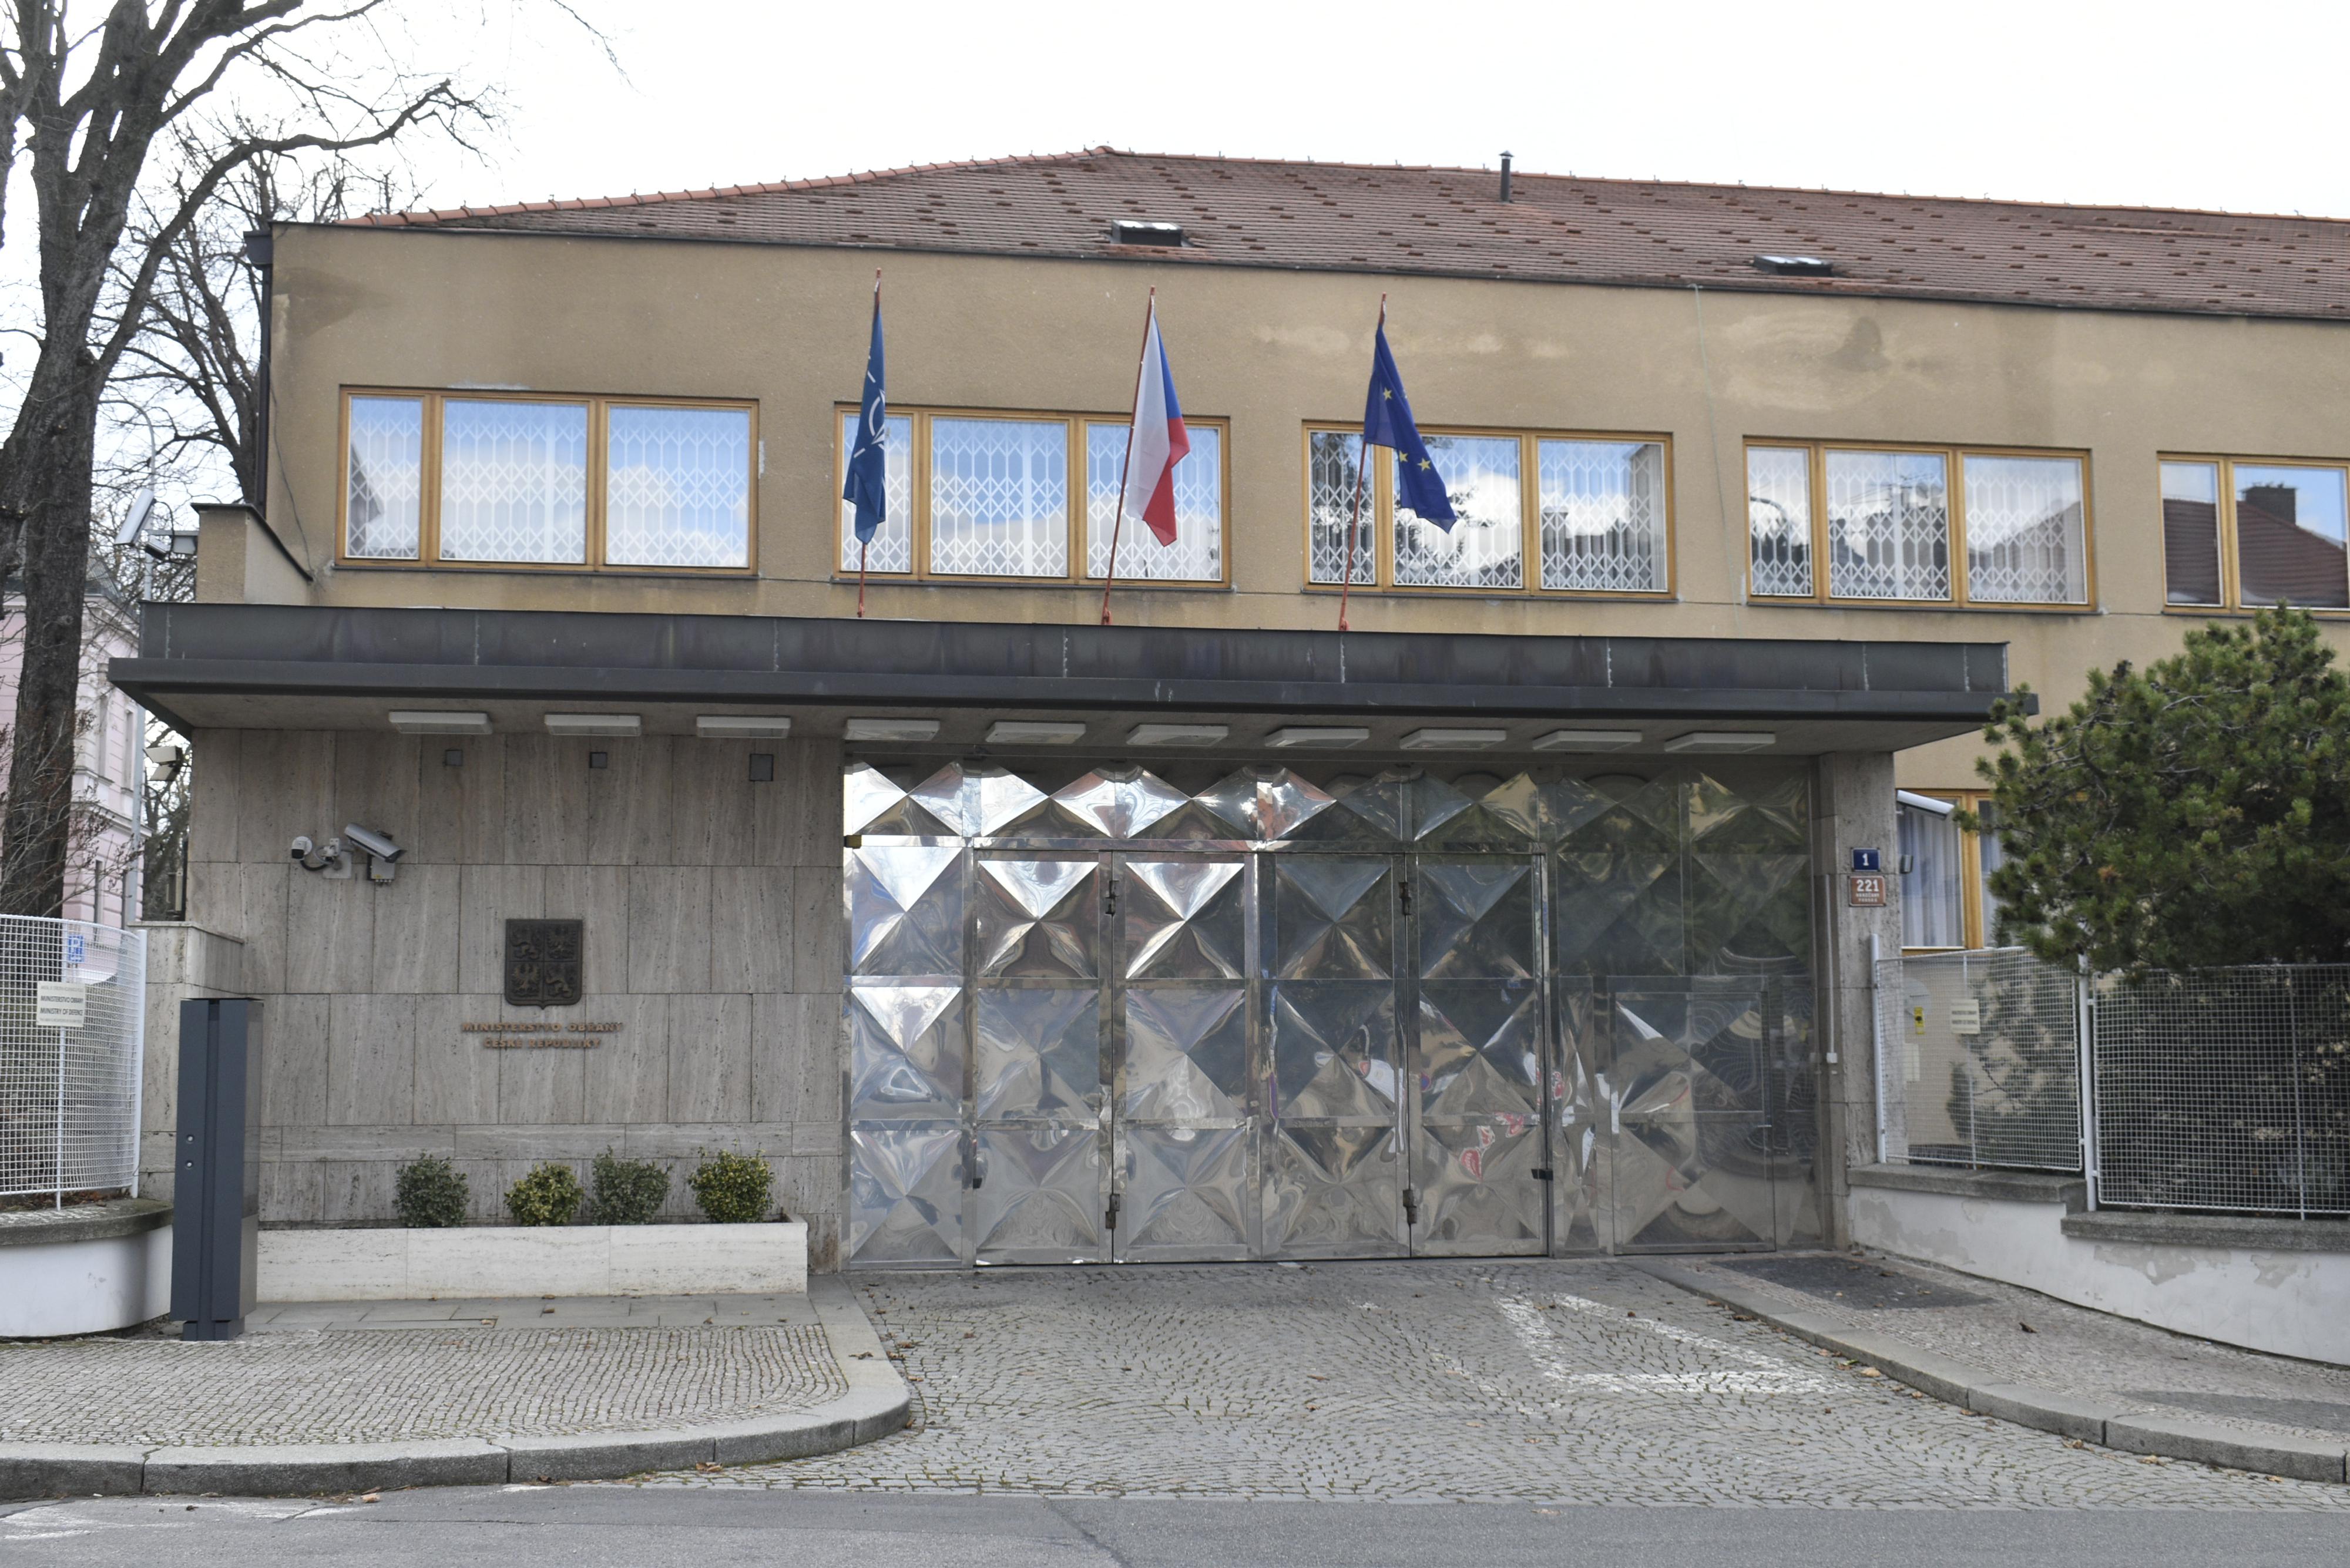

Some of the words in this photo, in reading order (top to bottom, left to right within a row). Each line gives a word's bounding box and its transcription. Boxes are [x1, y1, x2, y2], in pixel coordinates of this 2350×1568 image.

[1862, 853, 1869, 866] 1
[1856, 879, 1879, 892] 221
[462, 1023, 562, 1032] MINISTERSTVO
[568, 1022, 623, 1032] OBRANY
[484, 1036, 523, 1049] ČESKÉ
[529, 1038, 602, 1049] REPUBLIKY
